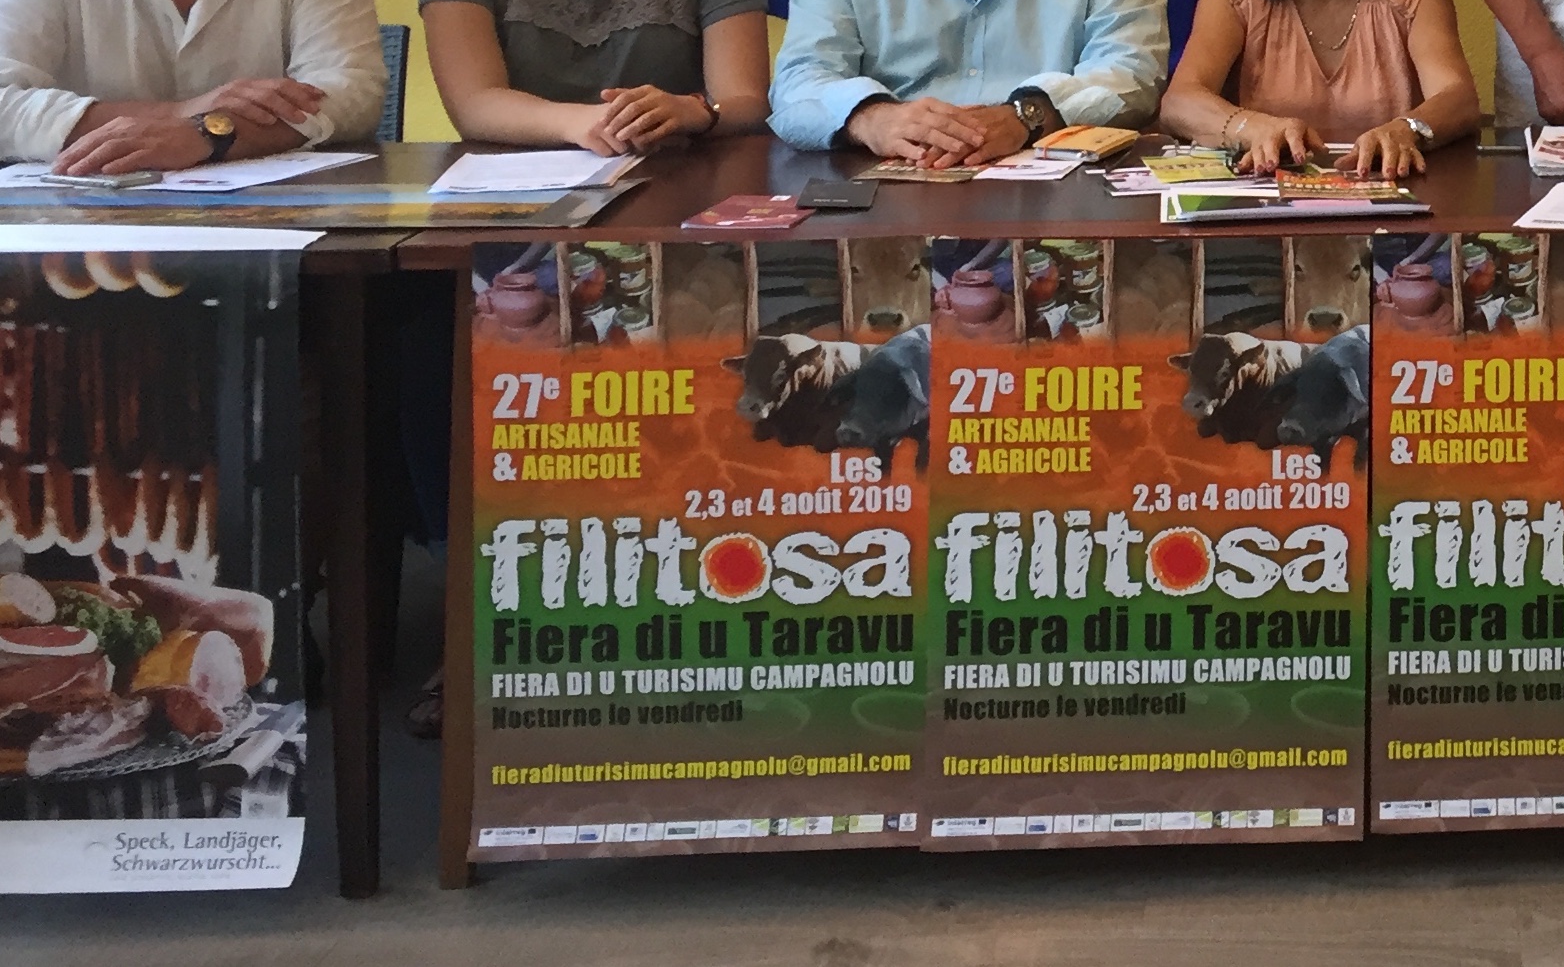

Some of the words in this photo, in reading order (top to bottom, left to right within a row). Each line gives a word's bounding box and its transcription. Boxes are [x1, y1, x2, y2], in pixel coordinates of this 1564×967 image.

[493, 373, 560, 418] 27e
[570, 369, 695, 417] FOIRE
[949, 368, 1015, 413] 27e
[1024, 366, 1143, 412] FOIRE
[1391, 360, 1453, 404] 27e
[492, 422, 640, 449] ARTISANALE
[947, 417, 1090, 444] ARTISANALE
[1390, 407, 1527, 434] ARTISANALE
[948, 446, 973, 475] &
[976, 447, 1091, 474] AGRICOLE
[1272, 449, 1322, 480] Les
[1390, 437, 1413, 464] &
[1417, 438, 1528, 464] AGRICOLE
[493, 452, 517, 481] &
[522, 453, 641, 480] AGRICOLE
[831, 452, 882, 483] Les
[685, 489, 725, 520] 2,3
[732, 497, 752, 517] et
[757, 488, 775, 515] 4
[781, 486, 842, 515] août
[849, 485, 912, 513] 2019
[1132, 484, 1171, 514] 2,3
[1177, 491, 1197, 511] et
[1202, 483, 1219, 510] 4
[1224, 482, 1282, 510] août
[1289, 482, 1350, 509] 2019
[480, 517, 912, 612] filitosa
[935, 510, 1350, 603] filitosa
[944, 610, 1068, 657] Fiera
[1083, 605, 1129, 653] di
[1144, 612, 1171, 652] u
[1186, 605, 1351, 651] Taravu
[1388, 597, 1506, 643] Fiera
[1521, 594, 1564, 641] di
[491, 617, 619, 665] Fiera
[635, 614, 683, 661] di
[699, 620, 728, 659] u
[743, 611, 914, 657] Taravu
[944, 664, 1010, 690] FIERA
[1016, 663, 1045, 688] DI
[1048, 663, 1064, 686] U
[1070, 659, 1187, 686] TURISIMU
[1193, 656, 1351, 683] CAMPAGNOLU
[1387, 650, 1450, 675] FIERA
[1457, 649, 1480, 673] DI
[1488, 649, 1502, 673] U
[491, 672, 560, 698] FIERA
[566, 672, 592, 696] DI
[599, 671, 615, 695] U
[624, 666, 743, 694] TURISIMU
[750, 661, 915, 691] CAMPAGNOLU
[1388, 683, 1490, 706] Nocturne
[1496, 681, 1517, 702] le
[492, 706, 601, 730] Nocturne
[609, 703, 630, 726] le
[637, 700, 742, 725] vendredi
[943, 697, 1050, 721] Nocturne
[1056, 695, 1079, 717] le
[1084, 692, 1186, 716] vendredi
[114, 832, 175, 853] Speck,
[184, 831, 282, 853] Landjäger,
[111, 850, 280, 871] Schwarzwurscht...
